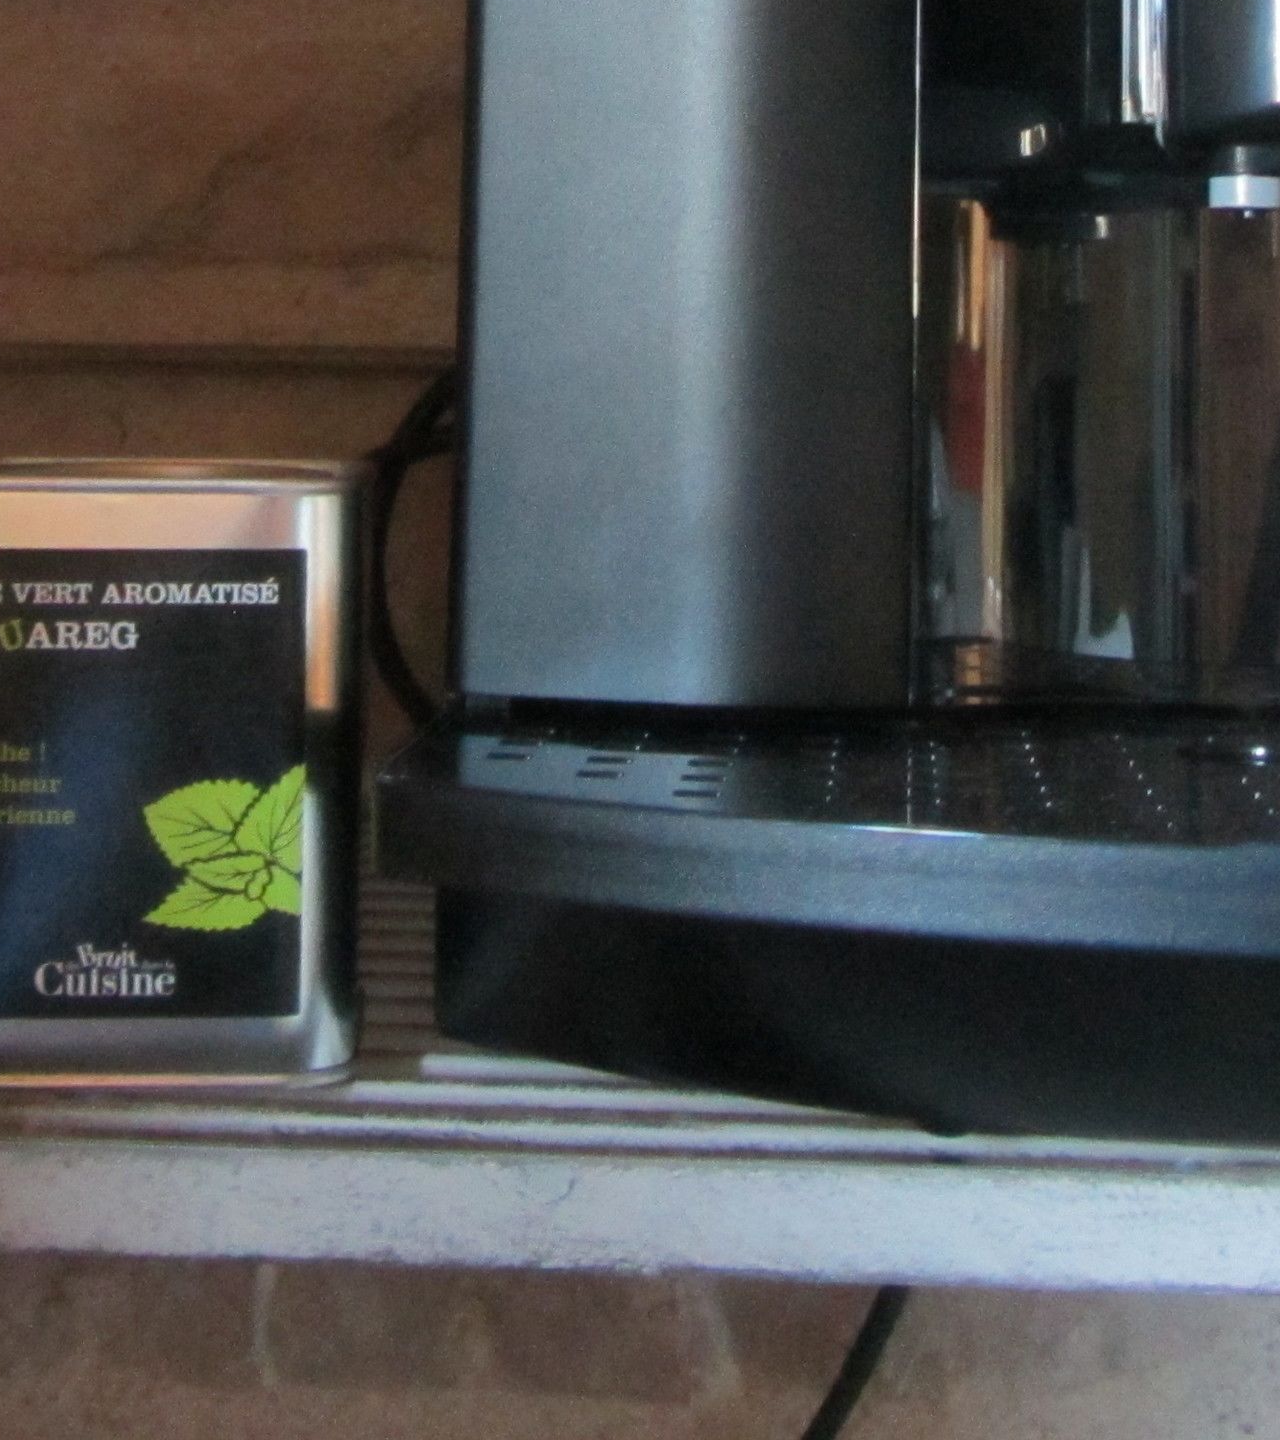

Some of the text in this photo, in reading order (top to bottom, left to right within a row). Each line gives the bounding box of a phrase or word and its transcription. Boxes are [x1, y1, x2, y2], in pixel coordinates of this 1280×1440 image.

[12, 582, 93, 605] VERT
[100, 576, 280, 605] AROMATISÉ
[34, 962, 177, 997] Cuisine
